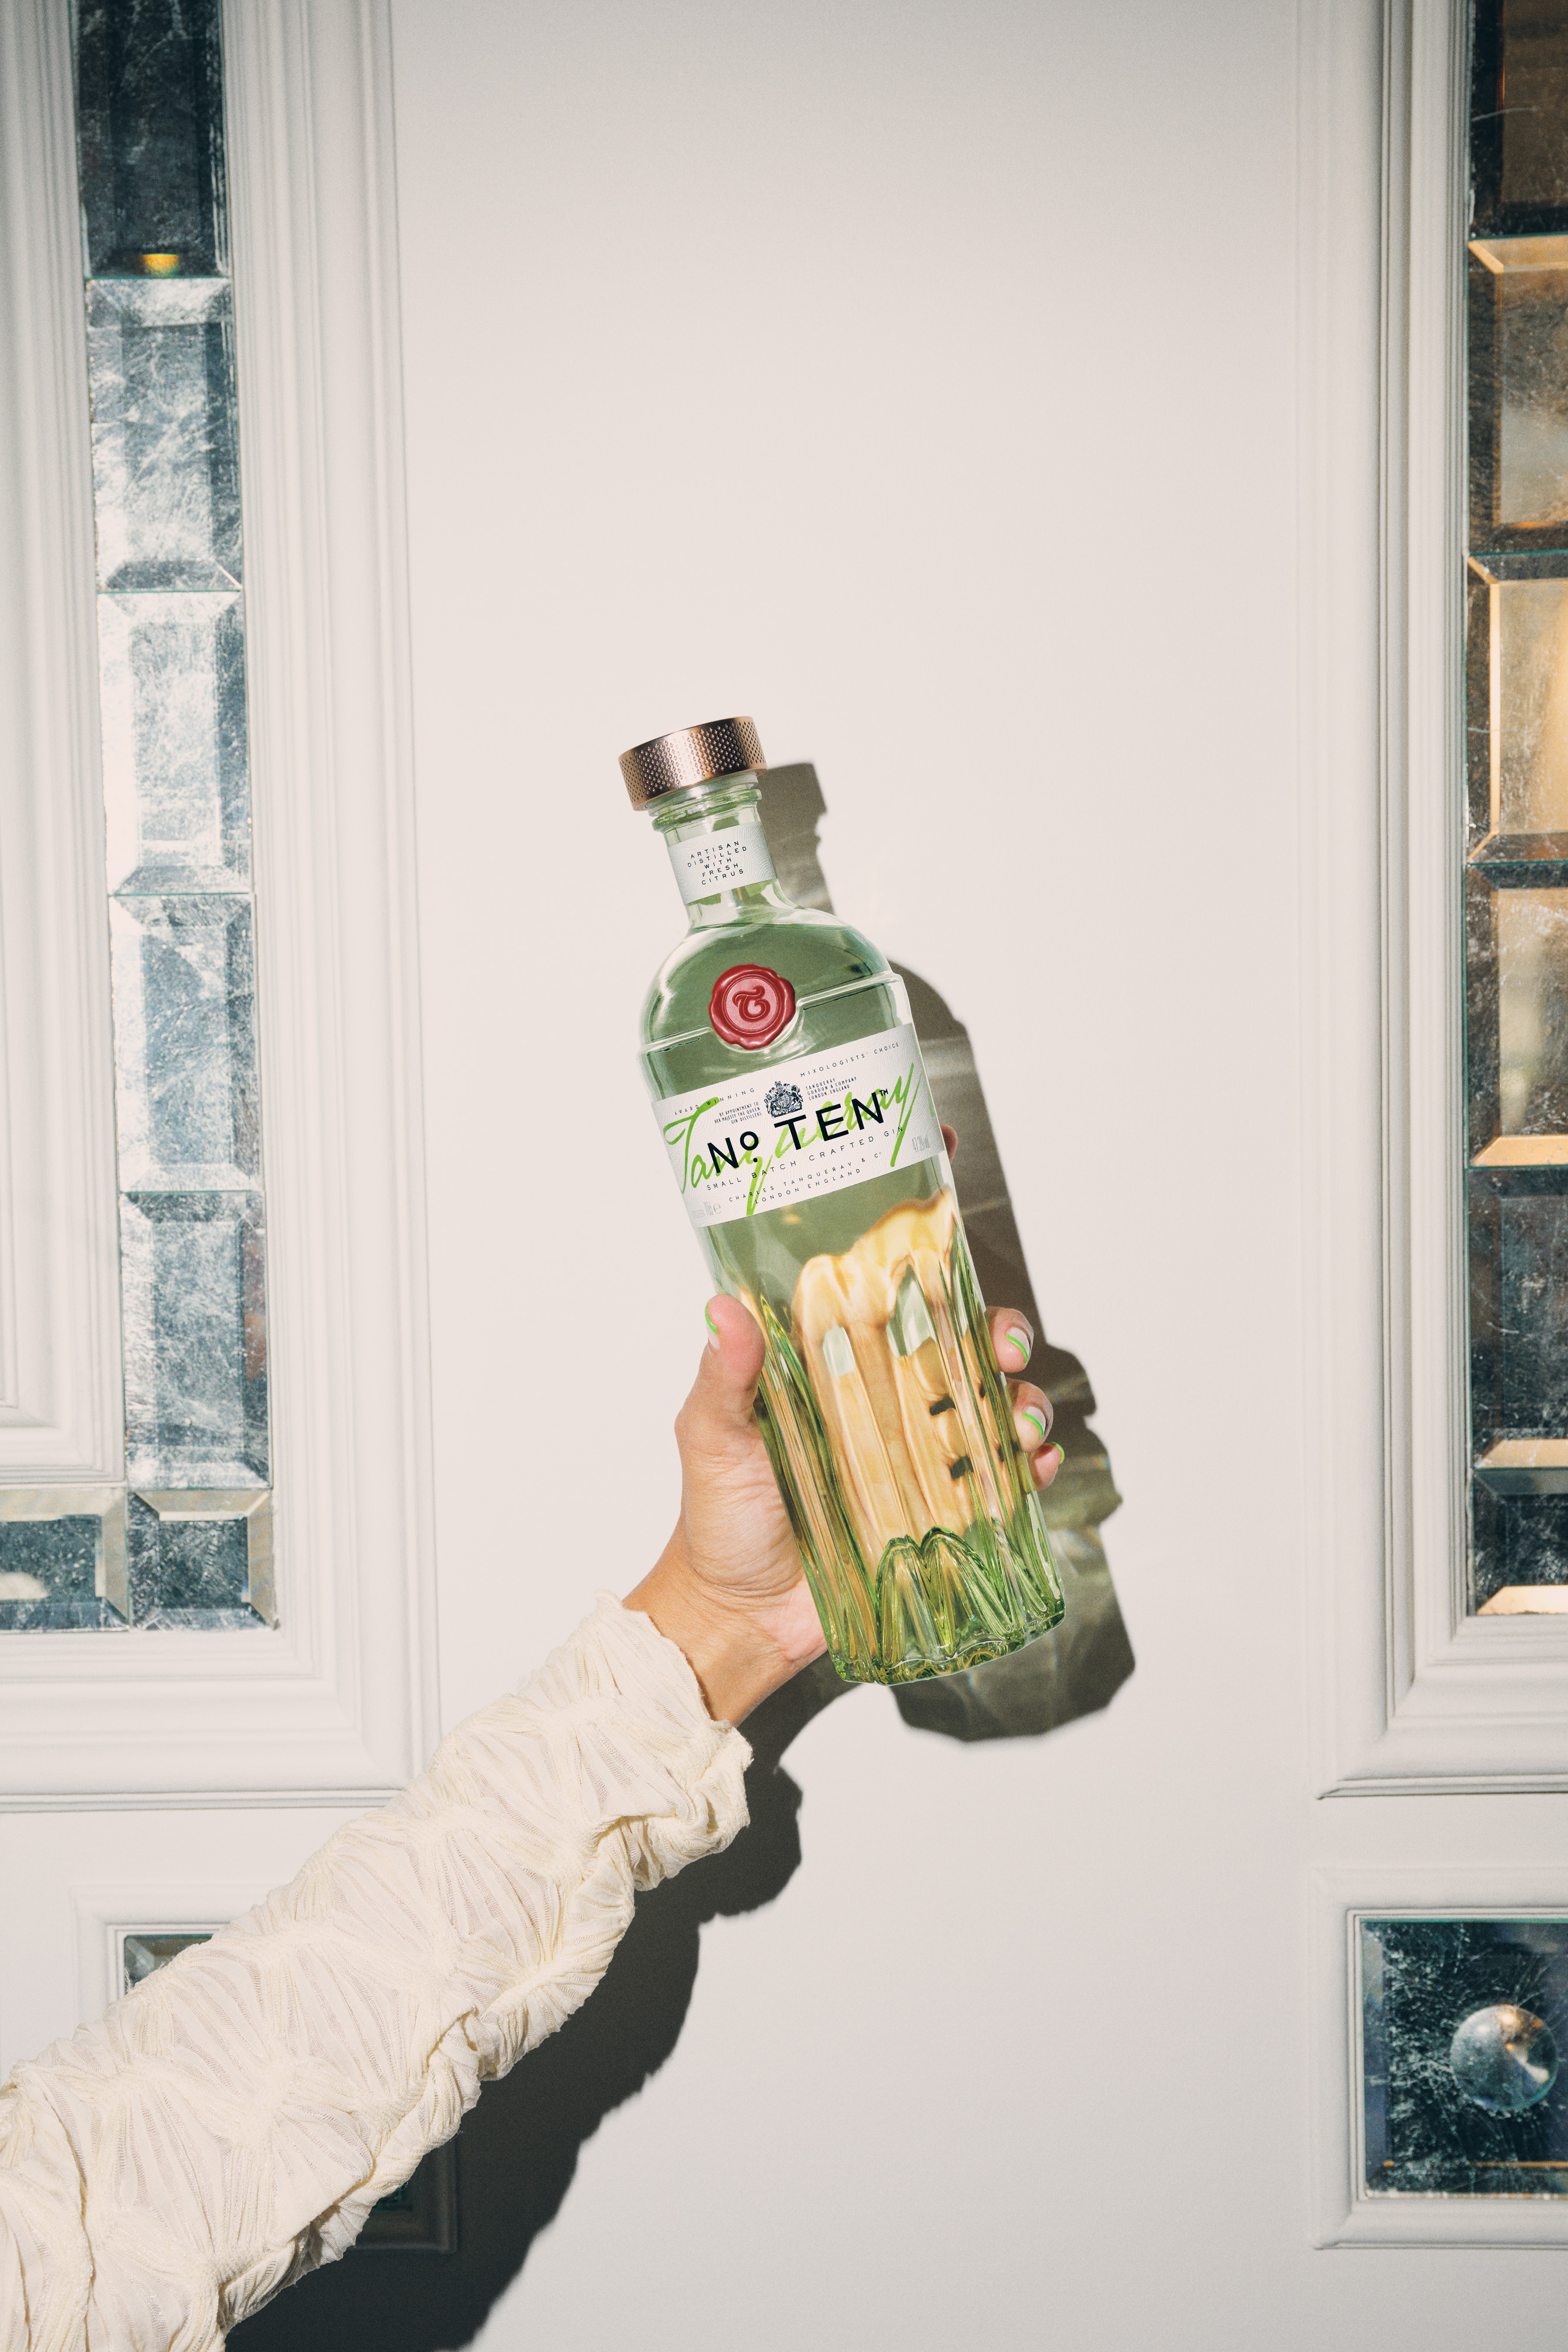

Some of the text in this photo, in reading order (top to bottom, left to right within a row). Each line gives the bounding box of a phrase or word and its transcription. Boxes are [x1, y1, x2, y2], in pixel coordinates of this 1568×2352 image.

[688, 846, 747, 867] DISTILLED
[690, 841, 739, 858] ARTISAN
[703, 863, 738, 877] FRESH
[704, 858, 731, 869] WITH
[701, 869, 743, 885] CITRUS
[874, 1043, 899, 1054] CHOICE
[805, 1078, 836, 1090] TANQUERAY
[807, 1085, 828, 1095] GORDON
[835, 1077, 857, 1087] COMPANY
[830, 1085, 850, 1094] ENGLAND
[674, 1088, 754, 1115] AWARD WINNING
[726, 1104, 752, 1115] APPOINTMENT
[740, 1112, 762, 1121] DISTILLERS
[707, 1126, 902, 1191] SMALL BATCH CRAFTED GIN
[730, 1186, 774, 1202] CHARLES
[784, 1162, 852, 1187] TANQUERAY
[755, 1168, 860, 1204] LONDON ENGLAND
